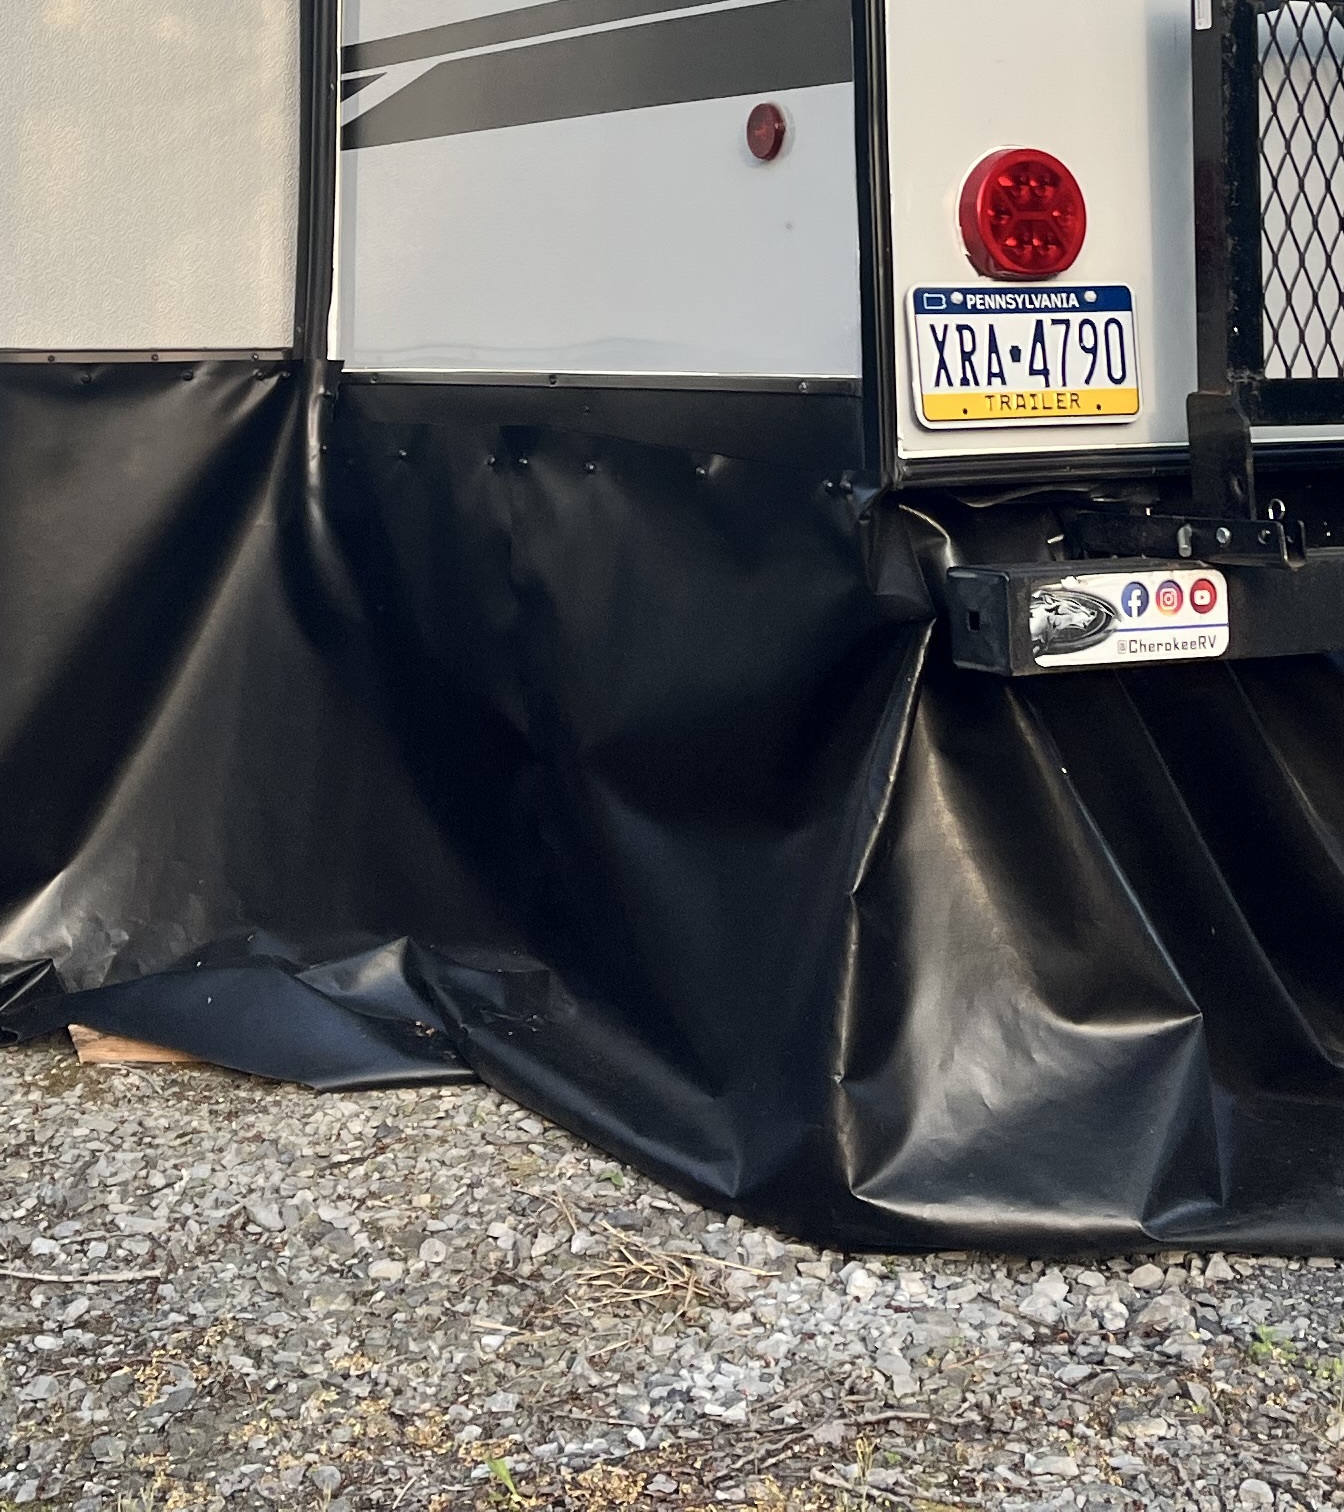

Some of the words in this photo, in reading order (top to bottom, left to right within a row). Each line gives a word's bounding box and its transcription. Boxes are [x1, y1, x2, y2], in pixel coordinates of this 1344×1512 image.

[966, 292, 1080, 310] PENNSYLVANIA
[984, 392, 1081, 412] TRAILER
[1117, 635, 1217, 655] @CherokeeRV
